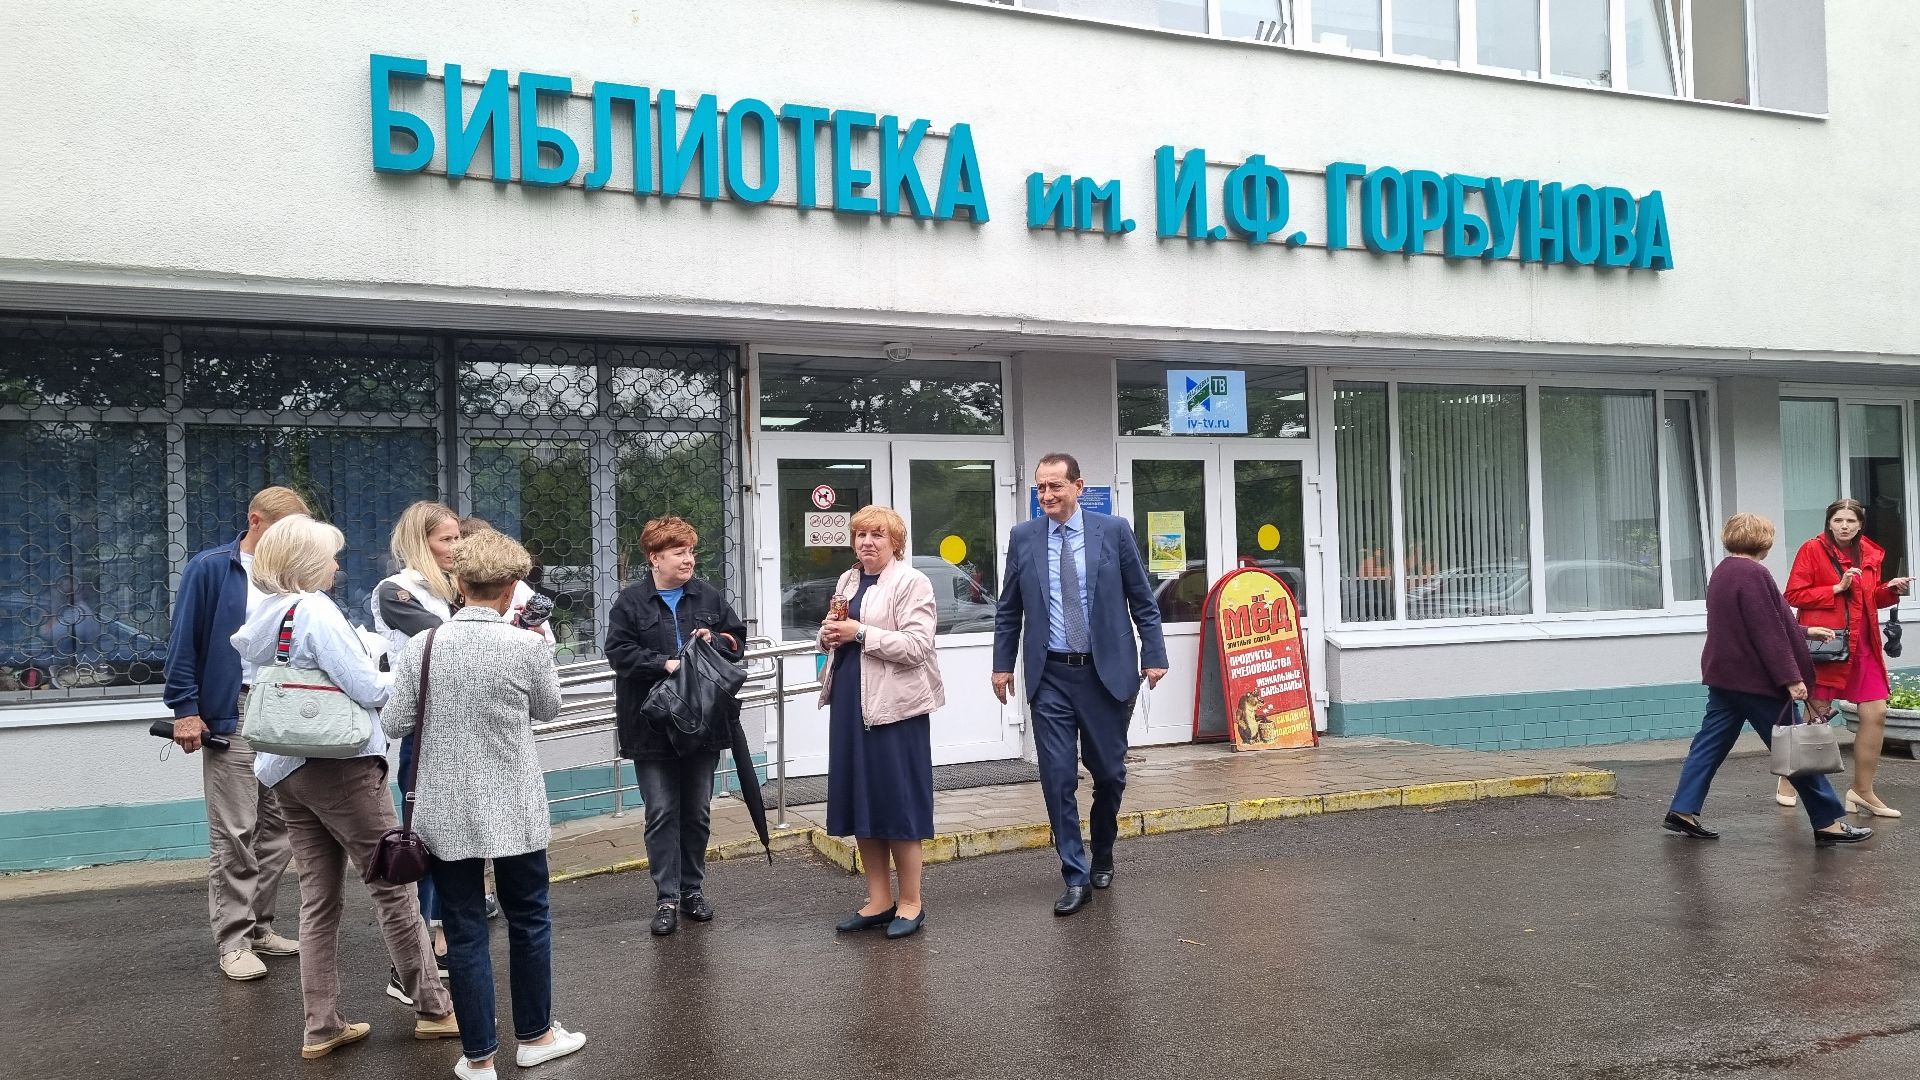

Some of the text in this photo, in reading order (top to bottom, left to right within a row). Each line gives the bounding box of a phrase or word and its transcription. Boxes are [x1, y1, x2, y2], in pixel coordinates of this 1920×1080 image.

[370, 54, 990, 224] БИБЛИОТЕКА
[1325, 161, 1674, 271] ГОРБУНОВА
[1187, 416, 1230, 429] iv-tv.ru
[1229, 648, 1273, 667] ПРОДУКТЫ
[1231, 656, 1292, 680] ПЧЕЛОВОДСТВА
[1260, 679, 1303, 697] БАЛЬЗАМЫ
